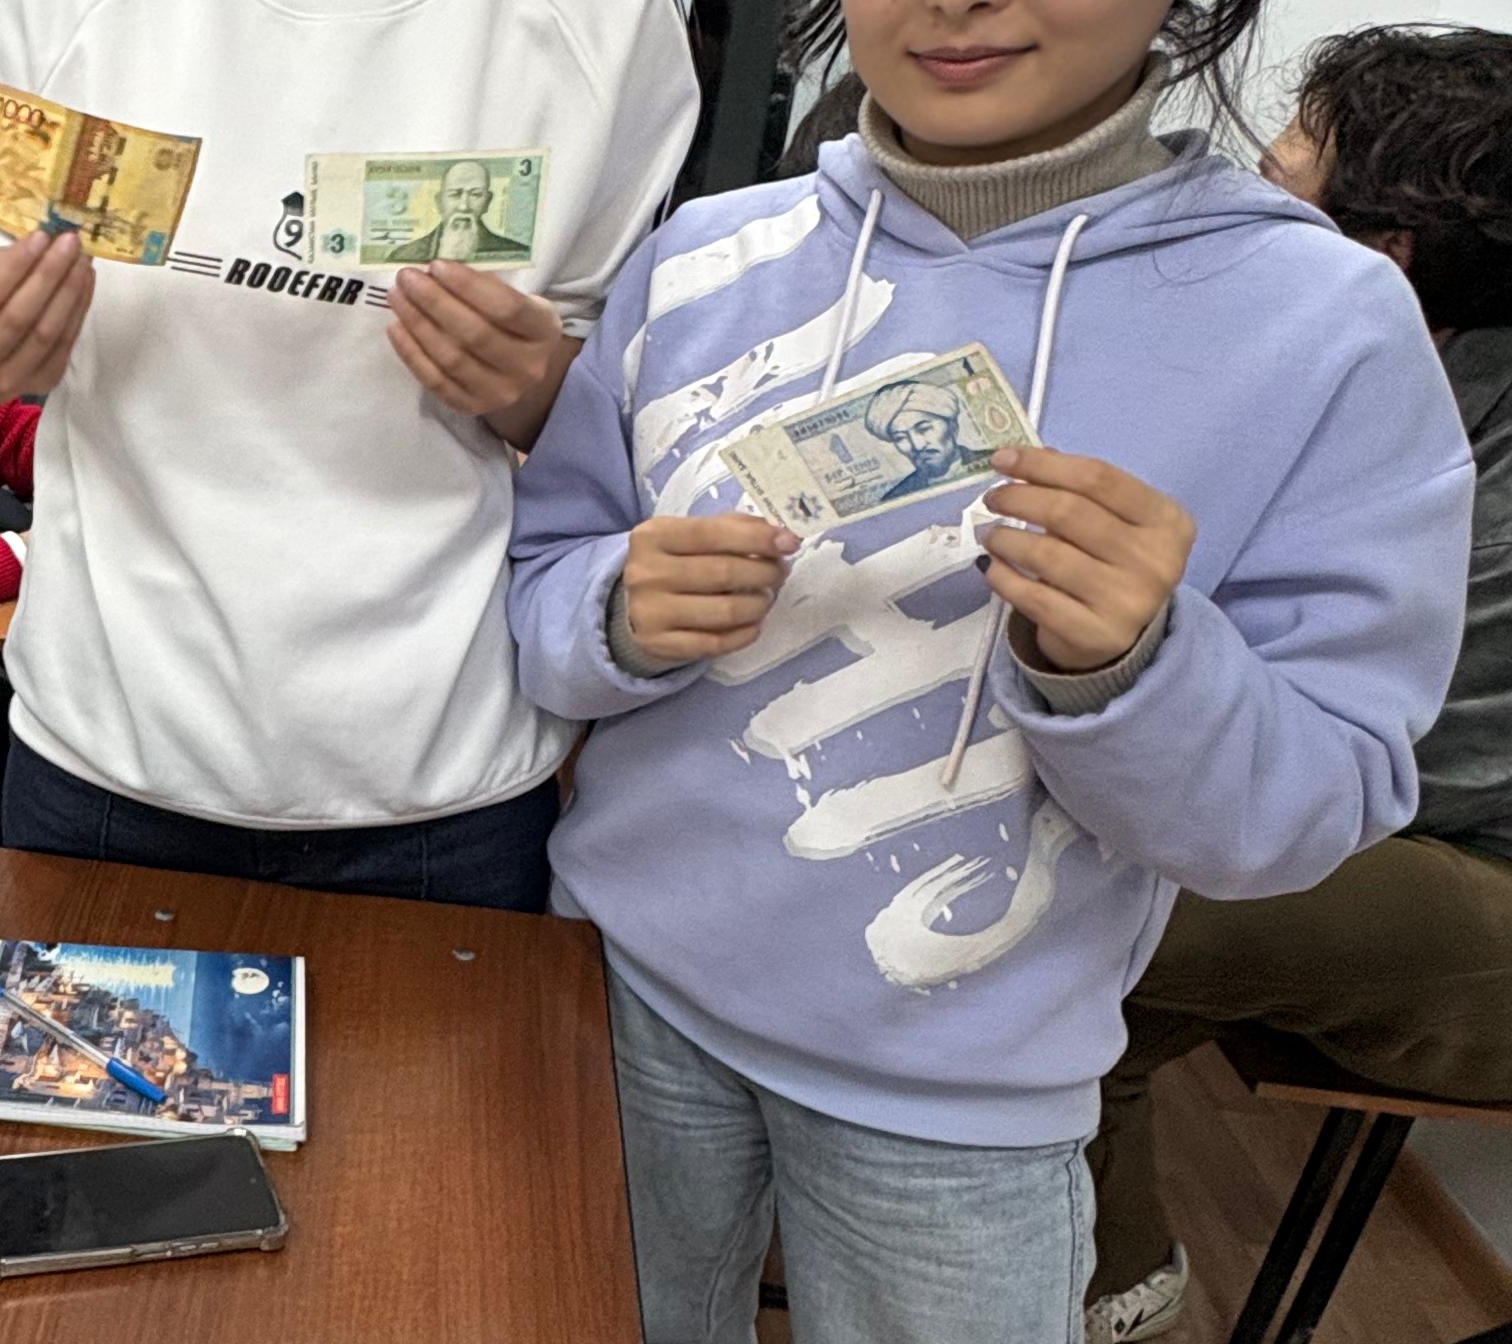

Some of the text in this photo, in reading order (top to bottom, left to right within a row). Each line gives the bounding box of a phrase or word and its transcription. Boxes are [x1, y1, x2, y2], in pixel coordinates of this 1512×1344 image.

[519, 159, 532, 177] 3
[386, 186, 409, 216] 3
[329, 233, 345, 254] 3
[962, 356, 975, 377] 1
[829, 433, 854, 465] 1
[798, 491, 813, 518] 1
